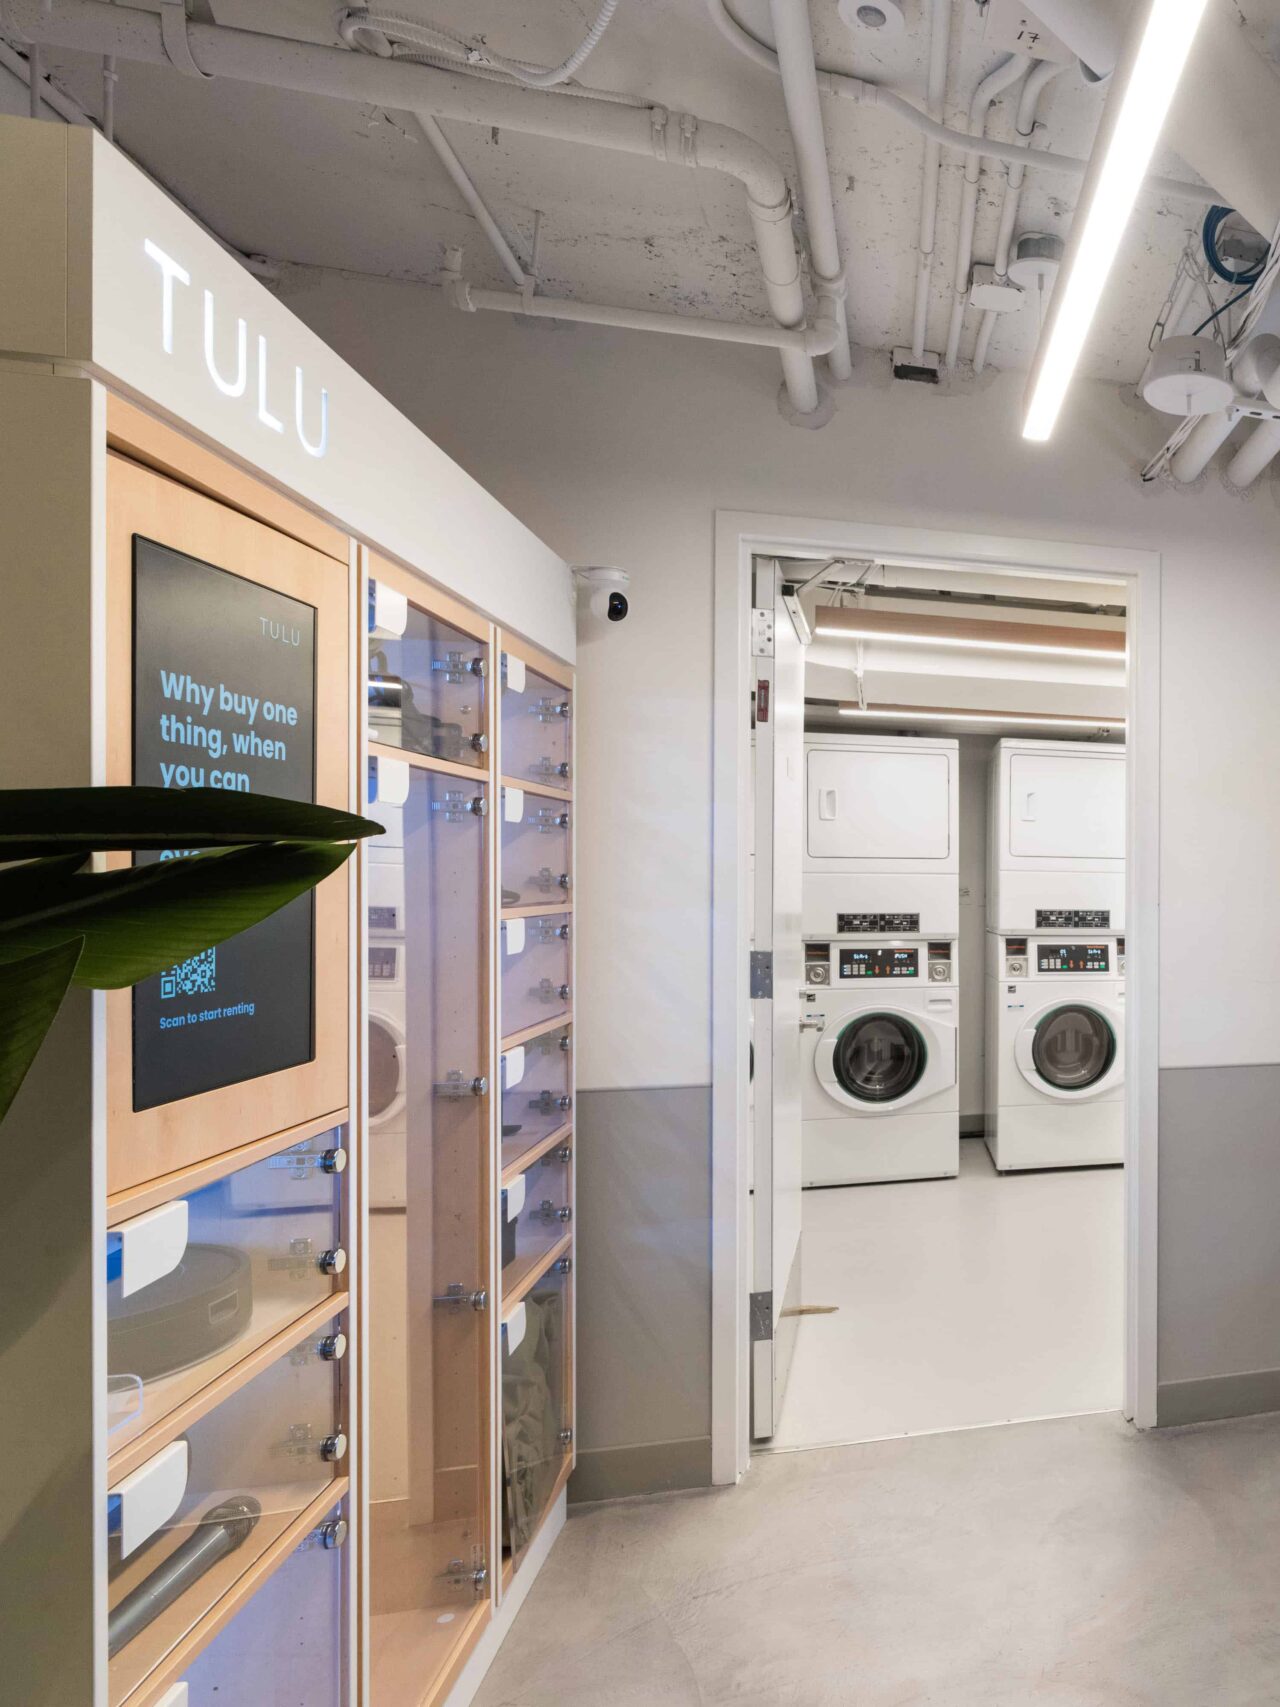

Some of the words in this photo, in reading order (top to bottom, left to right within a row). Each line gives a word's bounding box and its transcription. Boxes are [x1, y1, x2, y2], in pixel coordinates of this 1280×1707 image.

[1016, 30, 1041, 44] 17
[144, 237, 329, 459] TULU
[259, 616, 300, 647] TULU
[160, 669, 215, 716] Why
[219, 683, 264, 726] buy
[262, 700, 298, 727] one
[160, 713, 228, 759] thing,
[232, 730, 287, 761] when
[160, 762, 205, 788] you
[209, 769, 250, 793] can
[159, 1016, 186, 1029] Scan
[187, 1012, 198, 1024] to
[199, 1007, 222, 1021] start
[222, 1001, 255, 1016] renting
